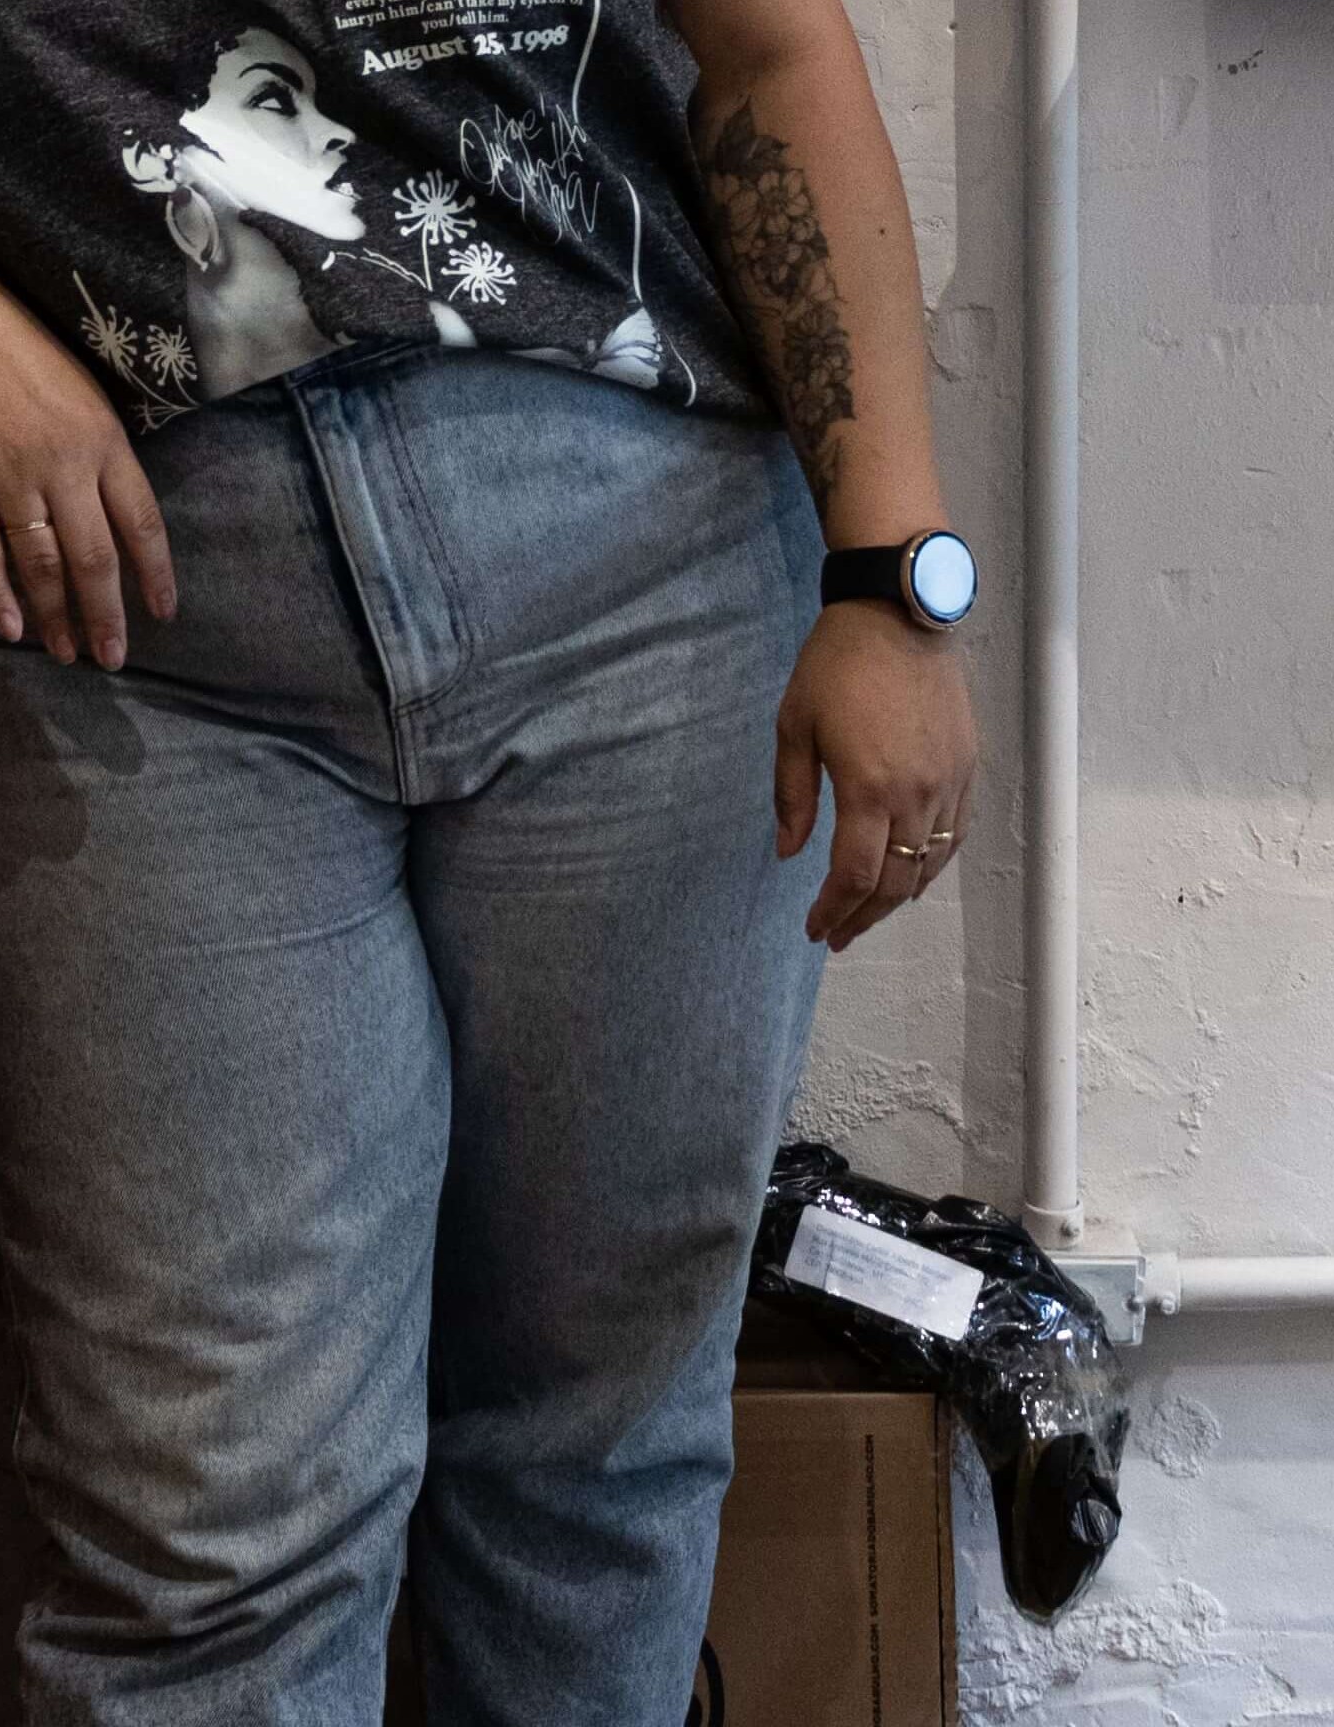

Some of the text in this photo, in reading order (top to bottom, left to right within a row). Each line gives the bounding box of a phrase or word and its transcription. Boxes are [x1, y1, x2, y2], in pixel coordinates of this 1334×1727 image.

[334, 10, 386, 30] lauryn
[361, 35, 468, 76] August
[509, 24, 570, 53] 1998
